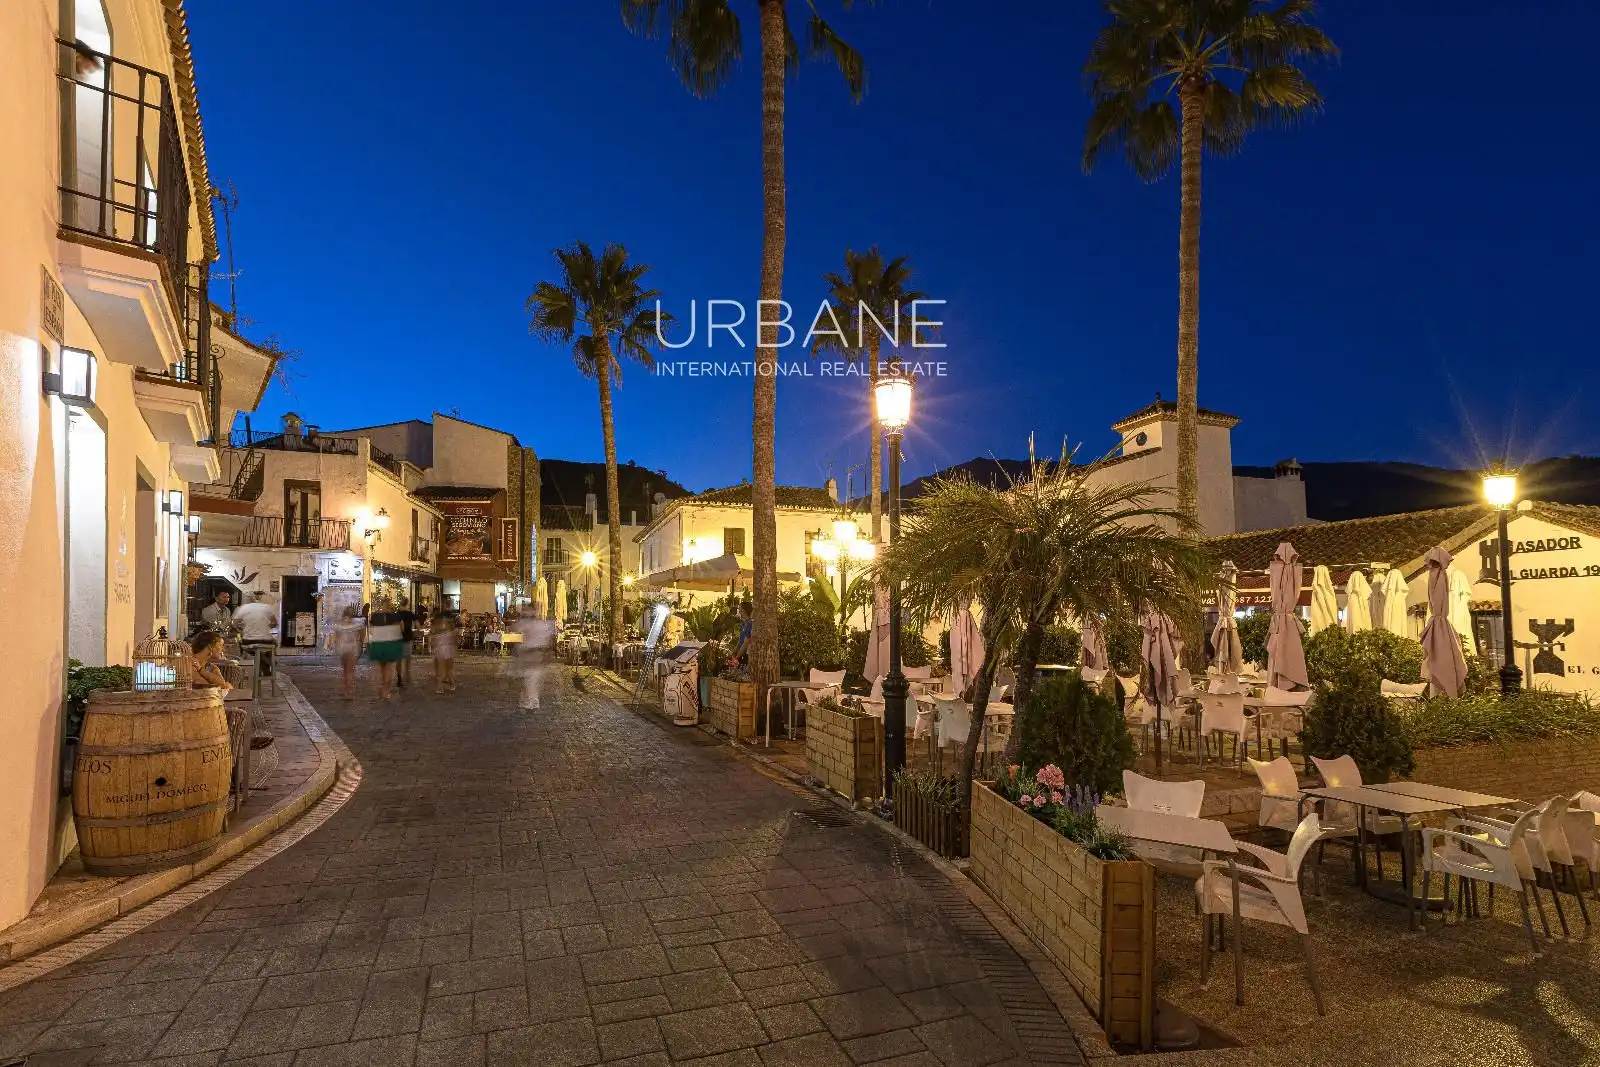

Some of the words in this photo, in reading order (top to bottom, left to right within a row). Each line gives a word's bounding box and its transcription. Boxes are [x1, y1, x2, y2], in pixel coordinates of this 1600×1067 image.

[1515, 536, 1582, 553] ASADOR
[1520, 566, 1579, 579] GUARDA
[1568, 665, 1584, 674] EL
[106, 792, 151, 804] MIGUEL
[156, 783, 209, 799] DOMECQ
